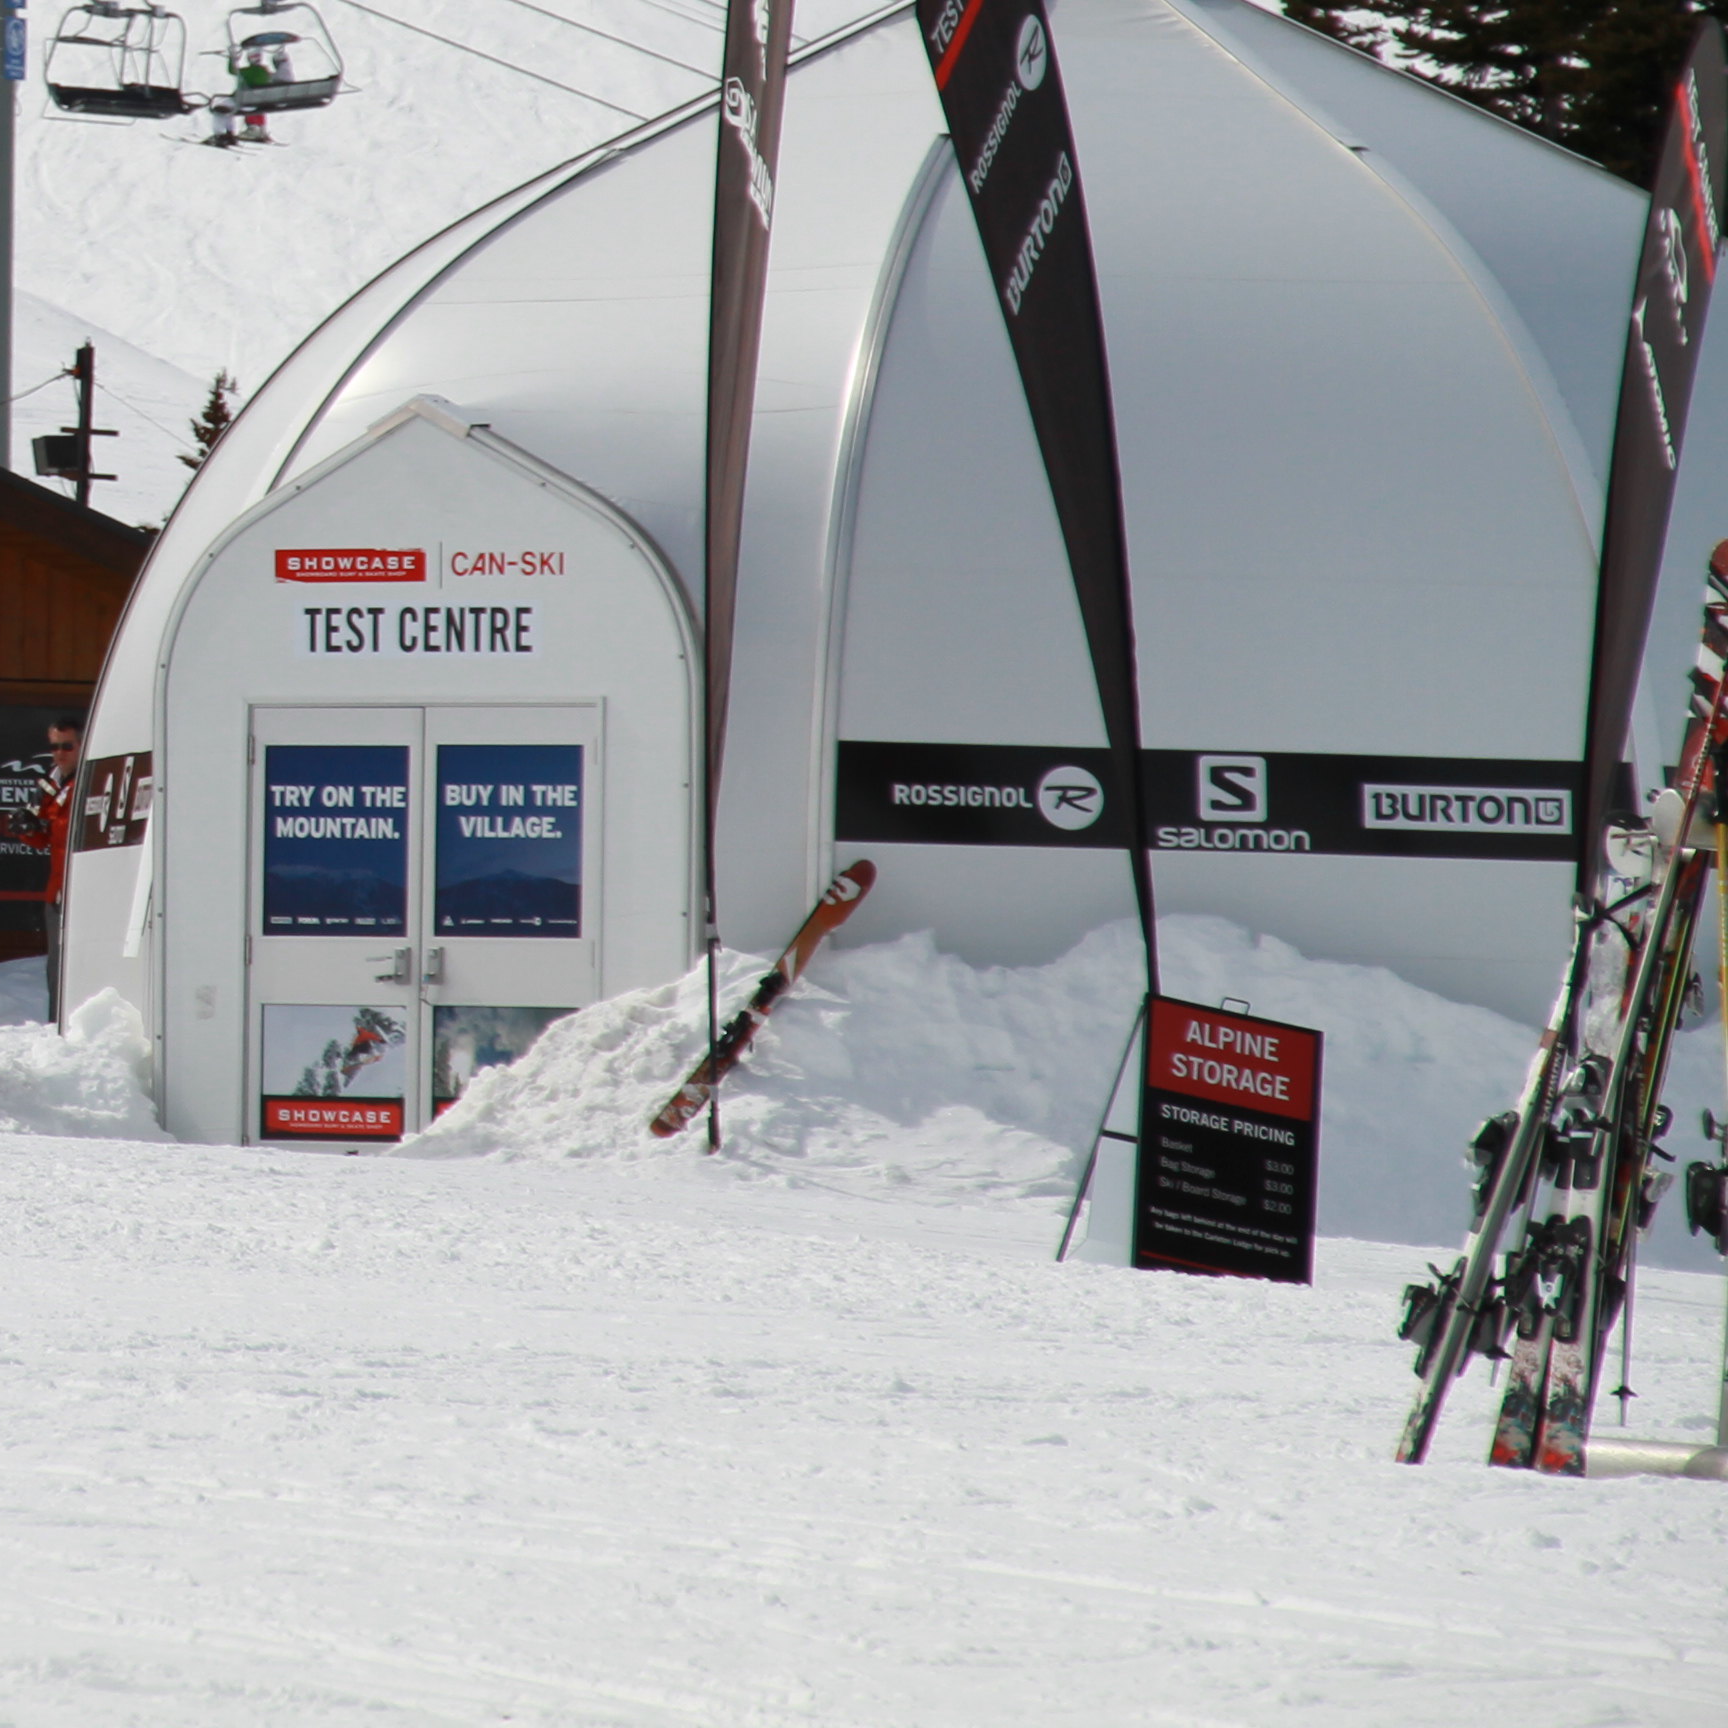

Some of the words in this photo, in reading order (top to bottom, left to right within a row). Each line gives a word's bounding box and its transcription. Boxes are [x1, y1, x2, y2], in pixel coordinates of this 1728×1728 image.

[971, 80, 1022, 195] ROSSIGNOL
[1006, 176, 1063, 317] BURTON
[1643, 342, 1676, 470] ATOMIC
[287, 556, 416, 571] SHOWCASE
[451, 552, 565, 577] CAN-SKI
[304, 607, 385, 653] TEST
[399, 607, 533, 653] CENTRE
[271, 785, 315, 807] TRY
[322, 786, 354, 807] ON
[361, 786, 406, 808] THE
[445, 784, 494, 806] BUY
[501, 785, 523, 806] IN
[531, 785, 578, 806] THE
[893, 784, 1033, 808] ROSSIGNOL
[1373, 792, 1532, 825] BURTON
[276, 817, 400, 840] MOUNTAIN.
[460, 816, 562, 839] VILLAGE.
[1186, 1020, 1279, 1062] ALPINE
[1171, 1053, 1290, 1101] STORAGE
[278, 1109, 391, 1123] SHOWCASE
[1161, 1104, 1229, 1132] STORAGE
[1234, 1119, 1295, 1146] PRICING
[1161, 1136, 1193, 1153] Basket
[1160, 1156, 1179, 1173] Bag
[1180, 1162, 1216, 1180] Storage
[1182, 1181, 1210, 1198] Board
[1212, 1188, 1247, 1206] Storage
